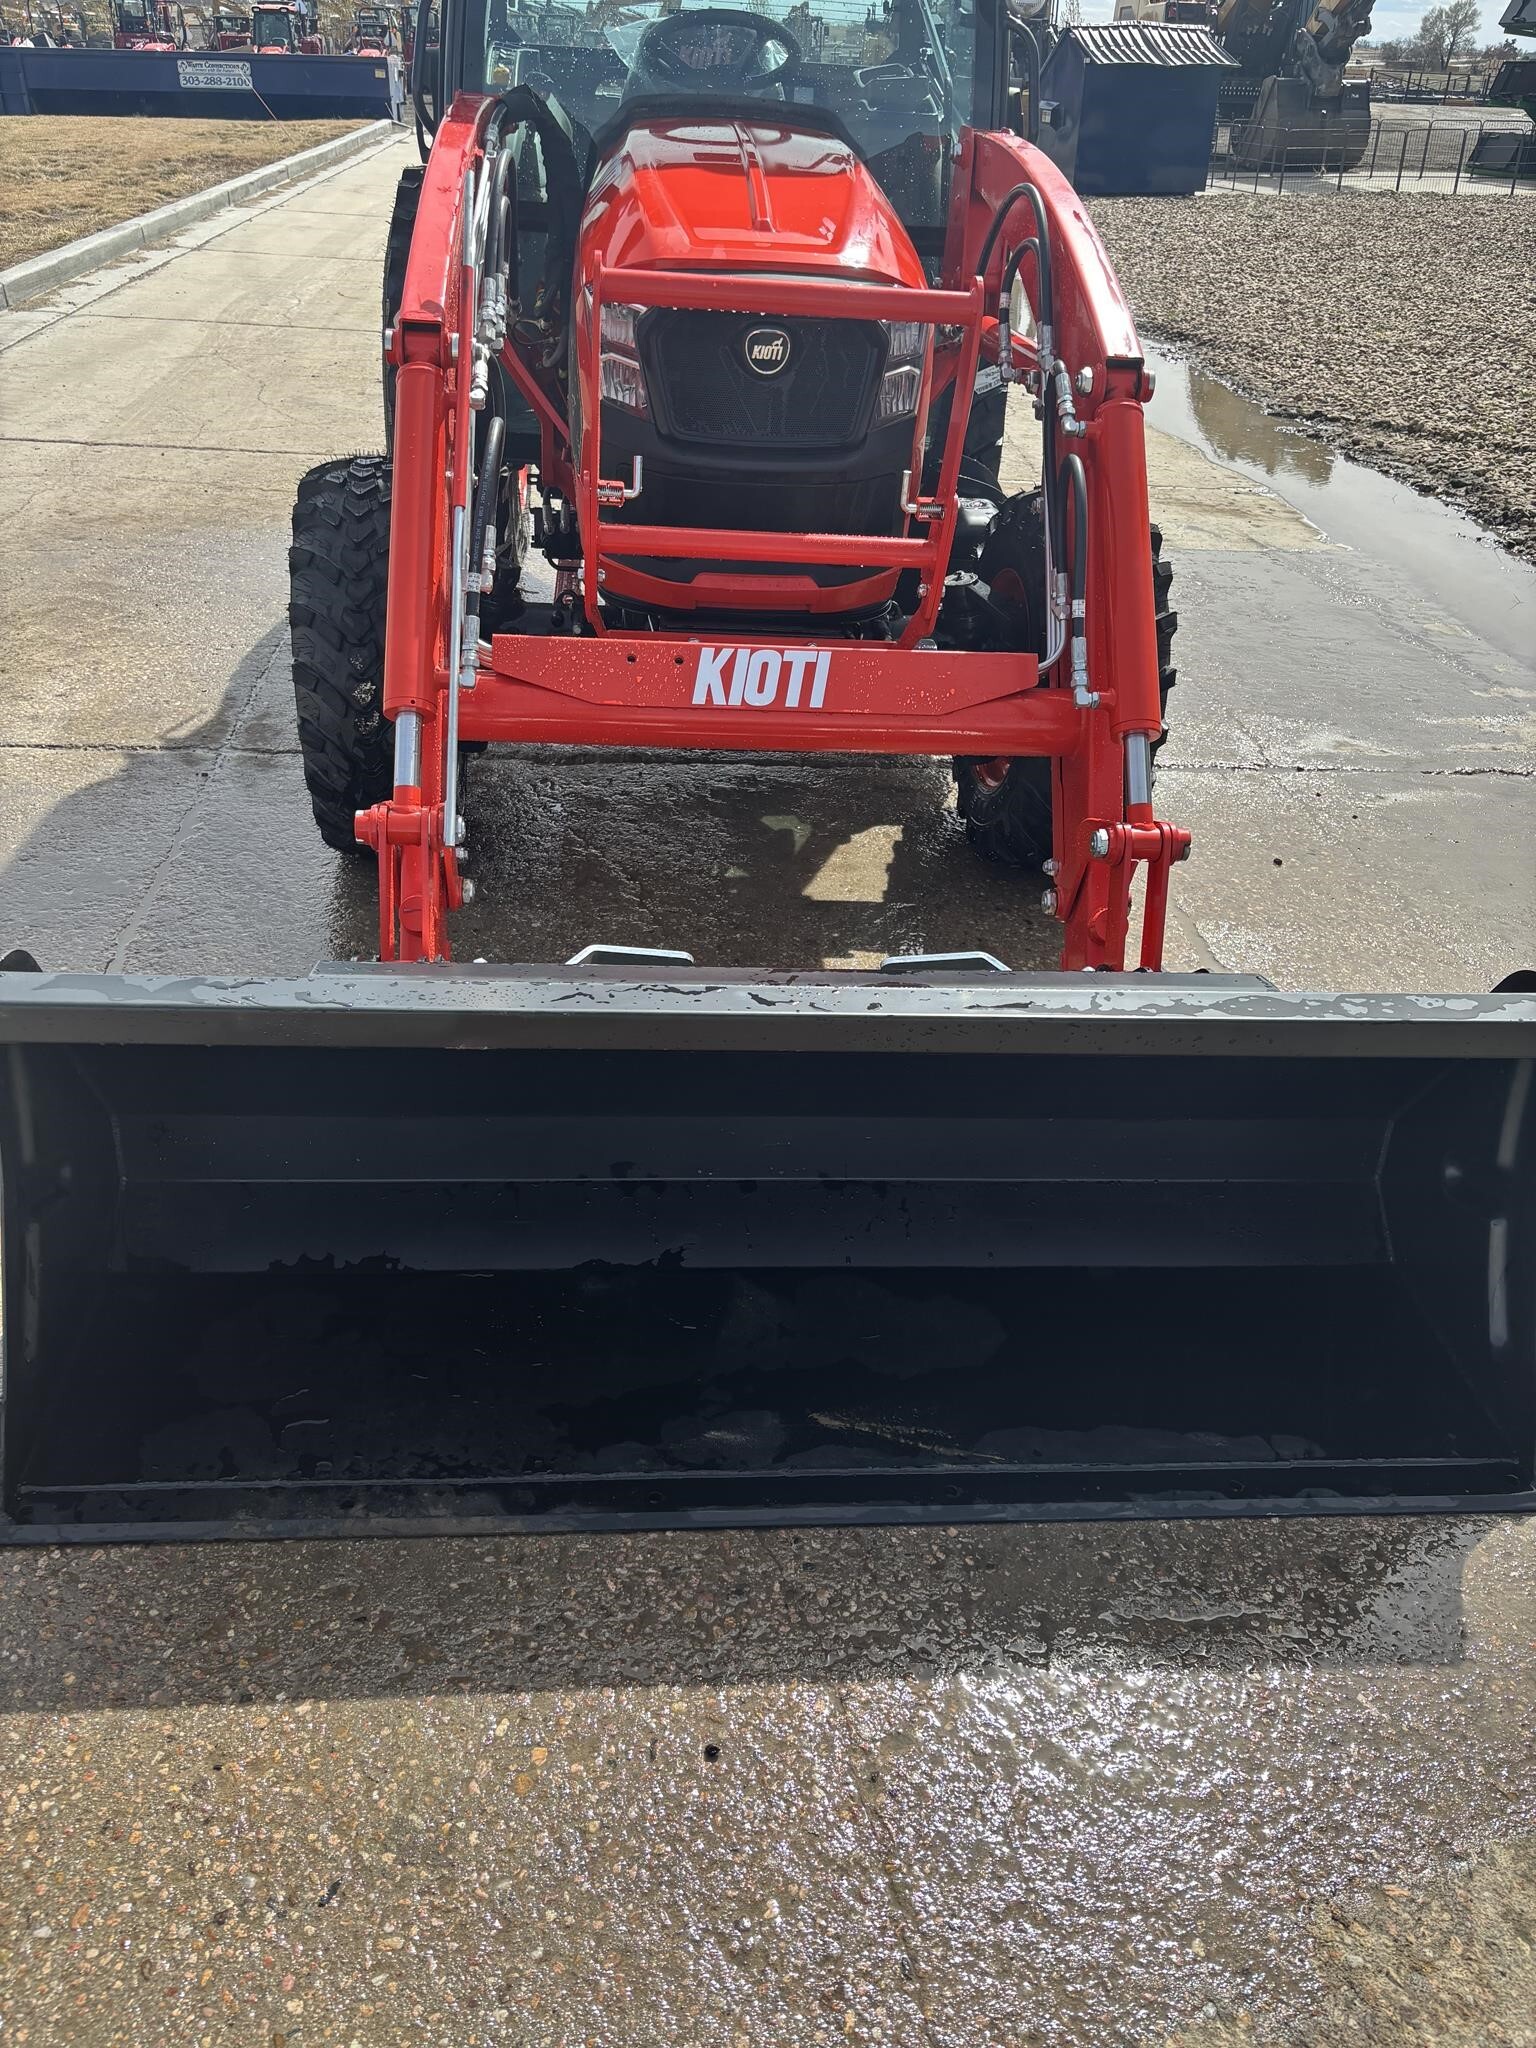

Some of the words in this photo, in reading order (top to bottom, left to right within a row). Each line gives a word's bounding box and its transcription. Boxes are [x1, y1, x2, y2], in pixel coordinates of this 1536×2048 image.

[182, 76, 251, 87] 303-288-2100
[751, 343, 784, 361] KIOTI
[692, 647, 832, 708] KIOTI
